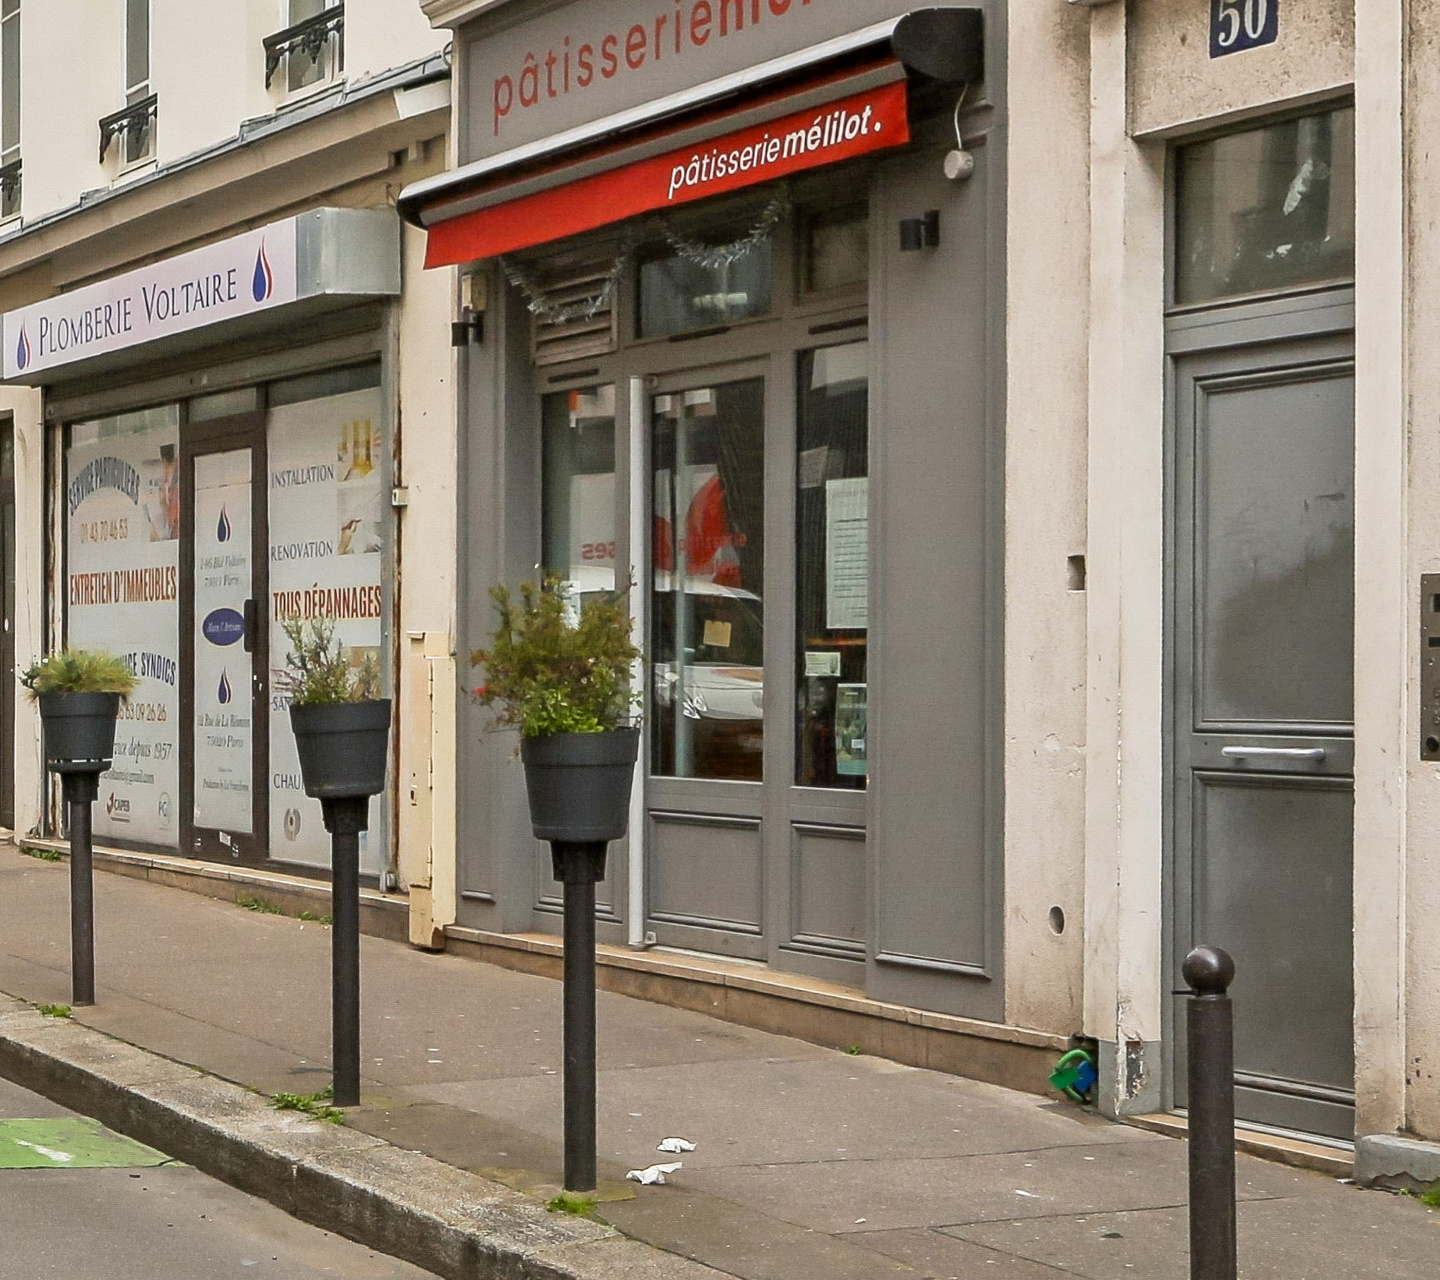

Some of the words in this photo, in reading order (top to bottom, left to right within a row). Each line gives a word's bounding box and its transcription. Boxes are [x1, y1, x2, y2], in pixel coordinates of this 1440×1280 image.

[39, 297, 132, 357] PLOMBERIE
[142, 268, 237, 324] VOLTAIRE
[271, 464, 334, 488] INSTALLATION
[271, 540, 333, 561] RENOVATION
[70, 571, 112, 605] ENTRETIEN
[114, 566, 177, 603] D'IMMEUBLES
[273, 590, 301, 621] TOUS
[305, 582, 382, 620] DÉPANNAGES
[141, 651, 176, 687] SYNDICS
